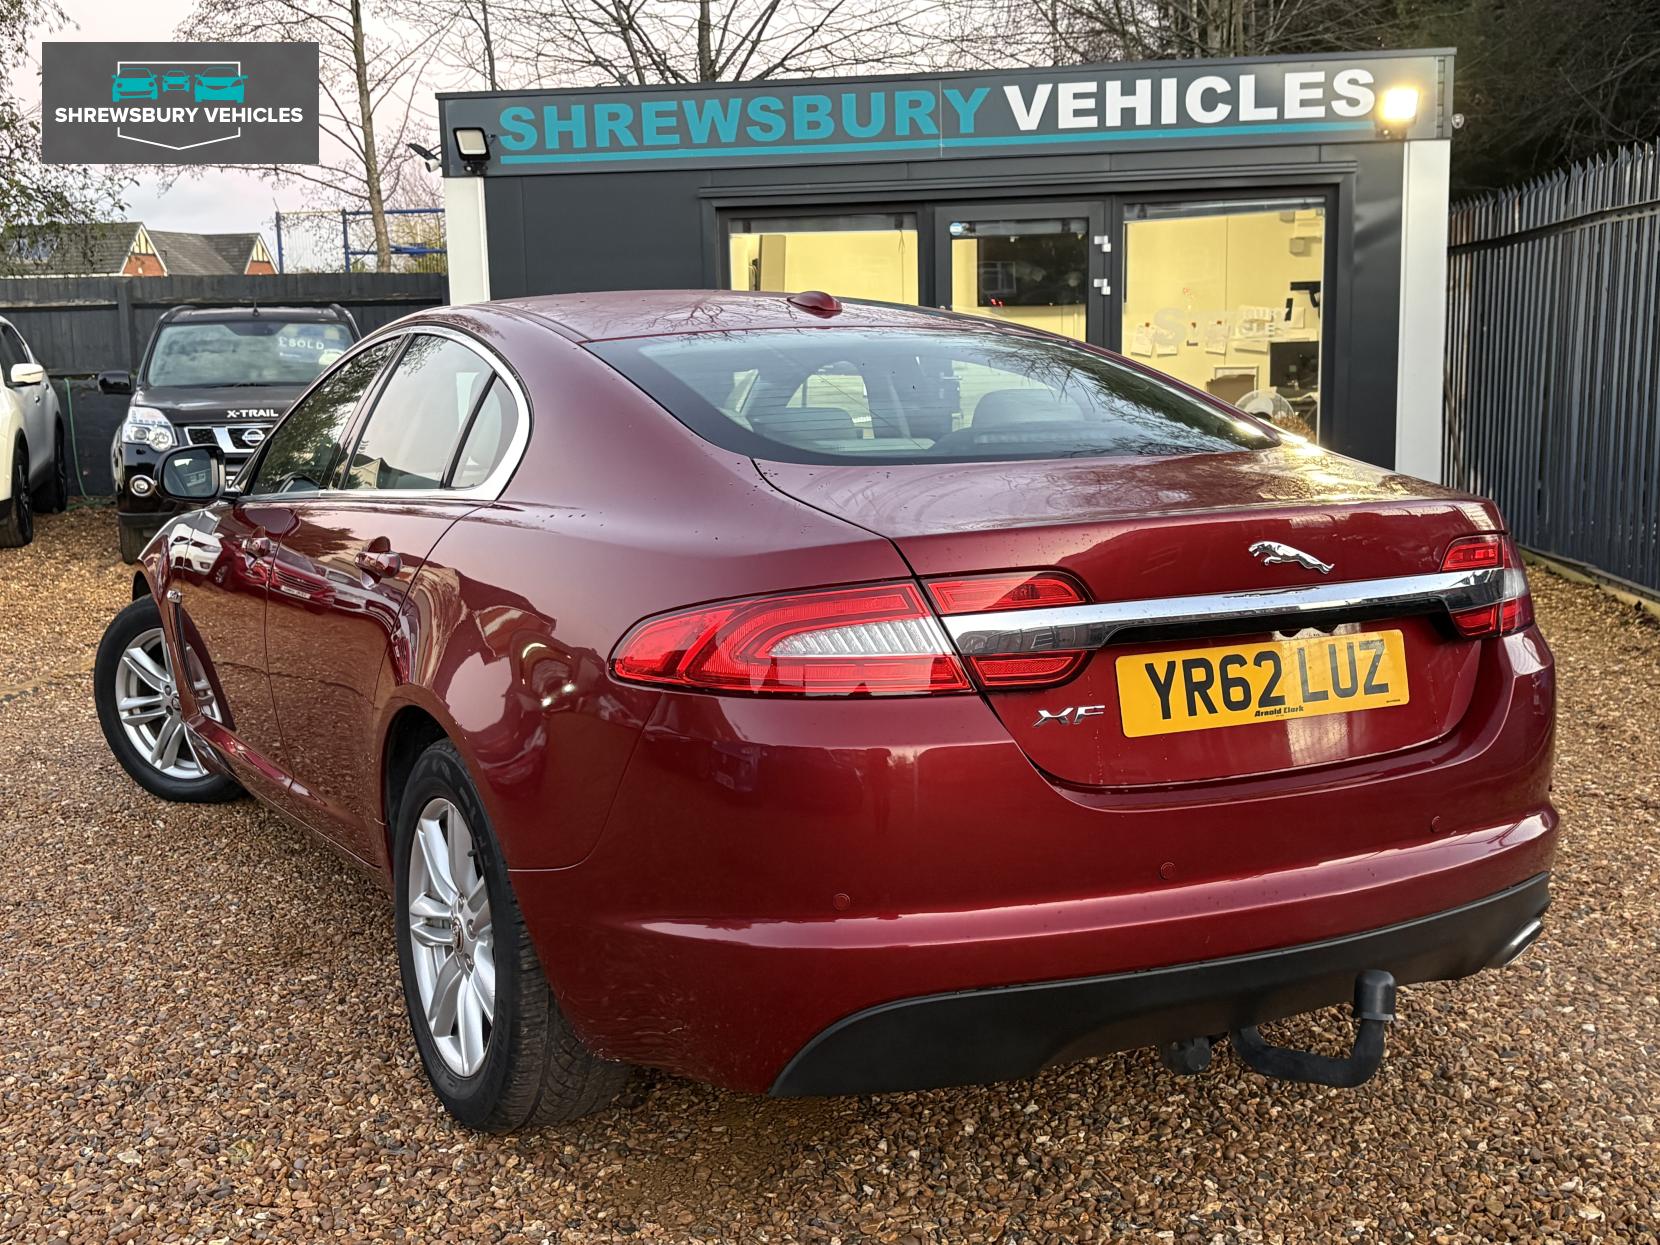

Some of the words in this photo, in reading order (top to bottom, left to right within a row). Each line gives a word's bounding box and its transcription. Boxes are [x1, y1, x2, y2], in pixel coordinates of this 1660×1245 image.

[498, 87, 991, 152] SHREWSBURY
[1002, 68, 1376, 131] VEHICLES
[226, 408, 279, 419] X-TRAIL
[1144, 650, 1286, 720] YR62
[1297, 638, 1390, 704] LUZ
[1032, 705, 1106, 728] XF
[1254, 707, 1282, 718] Arnold
[1283, 705, 1305, 714] Clark
